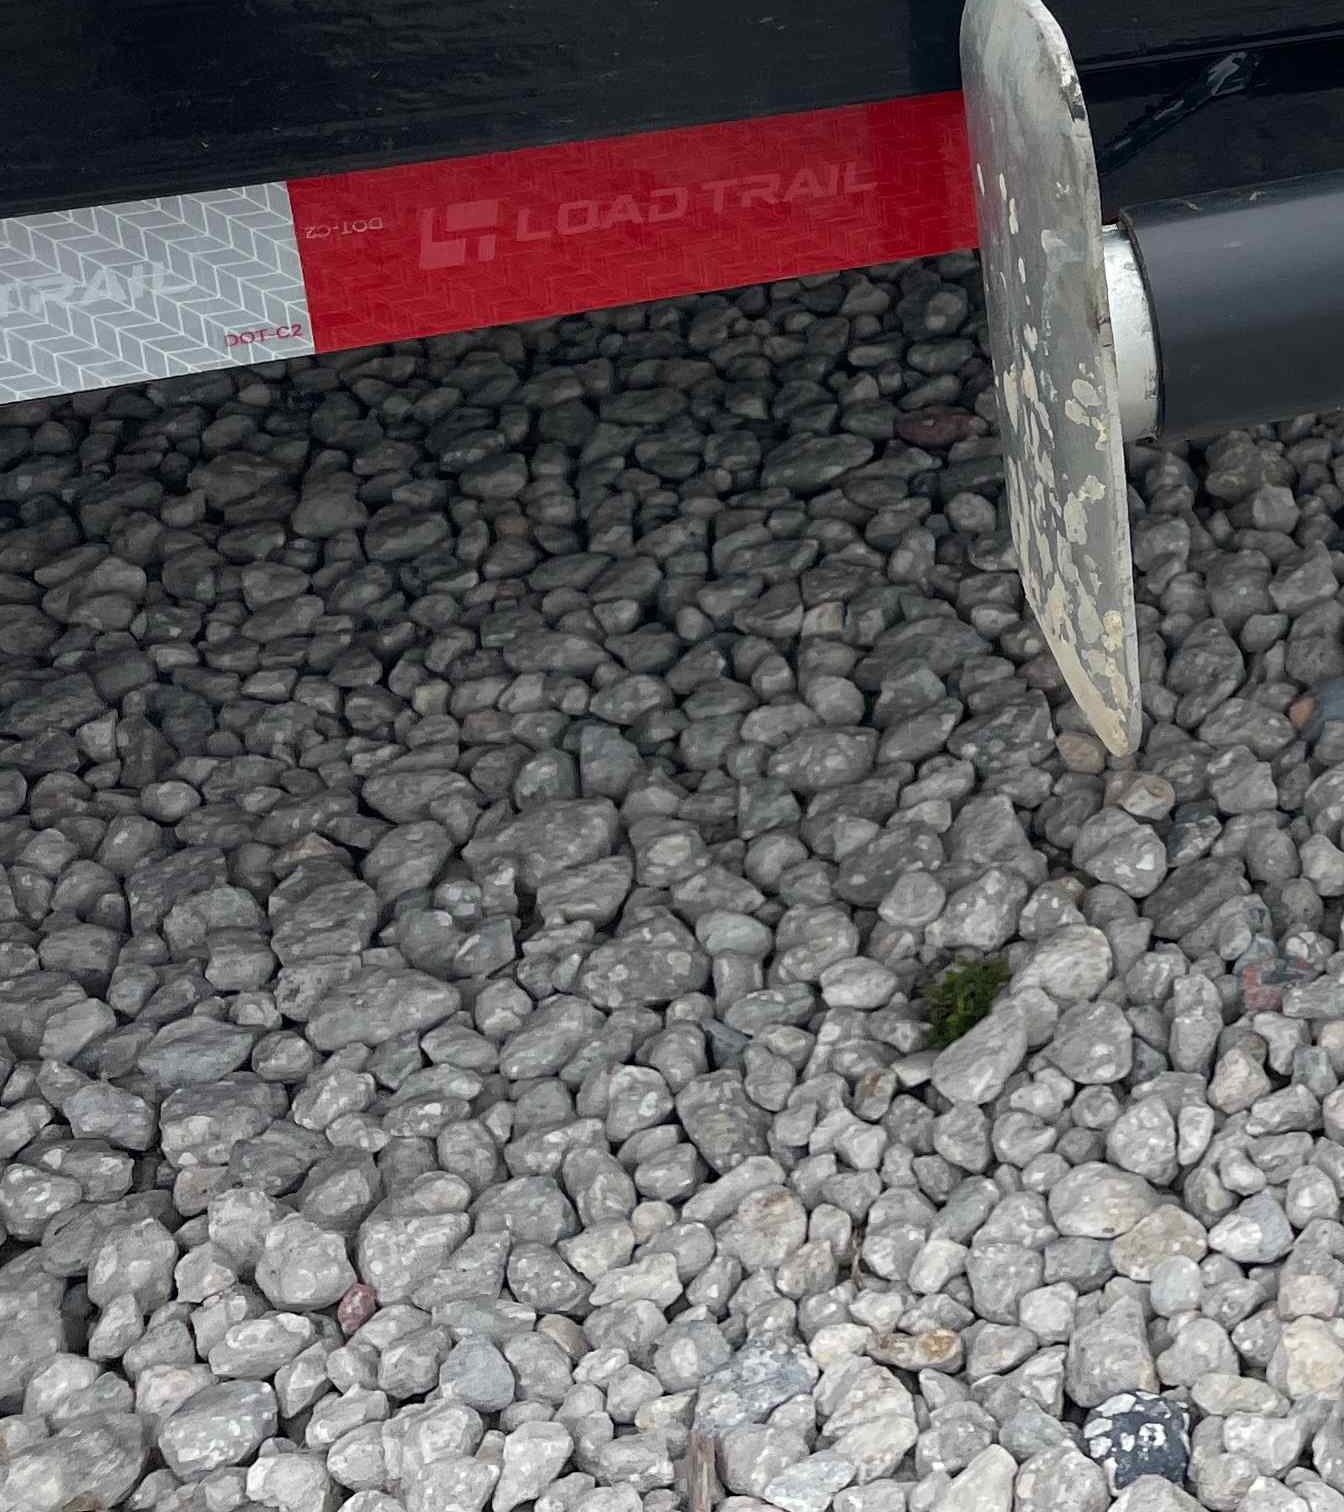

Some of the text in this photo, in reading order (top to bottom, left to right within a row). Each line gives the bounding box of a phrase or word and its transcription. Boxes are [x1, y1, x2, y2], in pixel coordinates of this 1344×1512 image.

[516, 186, 690, 242] LOAD
[701, 161, 878, 214] TRAIL
[303, 216, 385, 239] DOT-C2
[224, 323, 303, 348] DOT-C2
